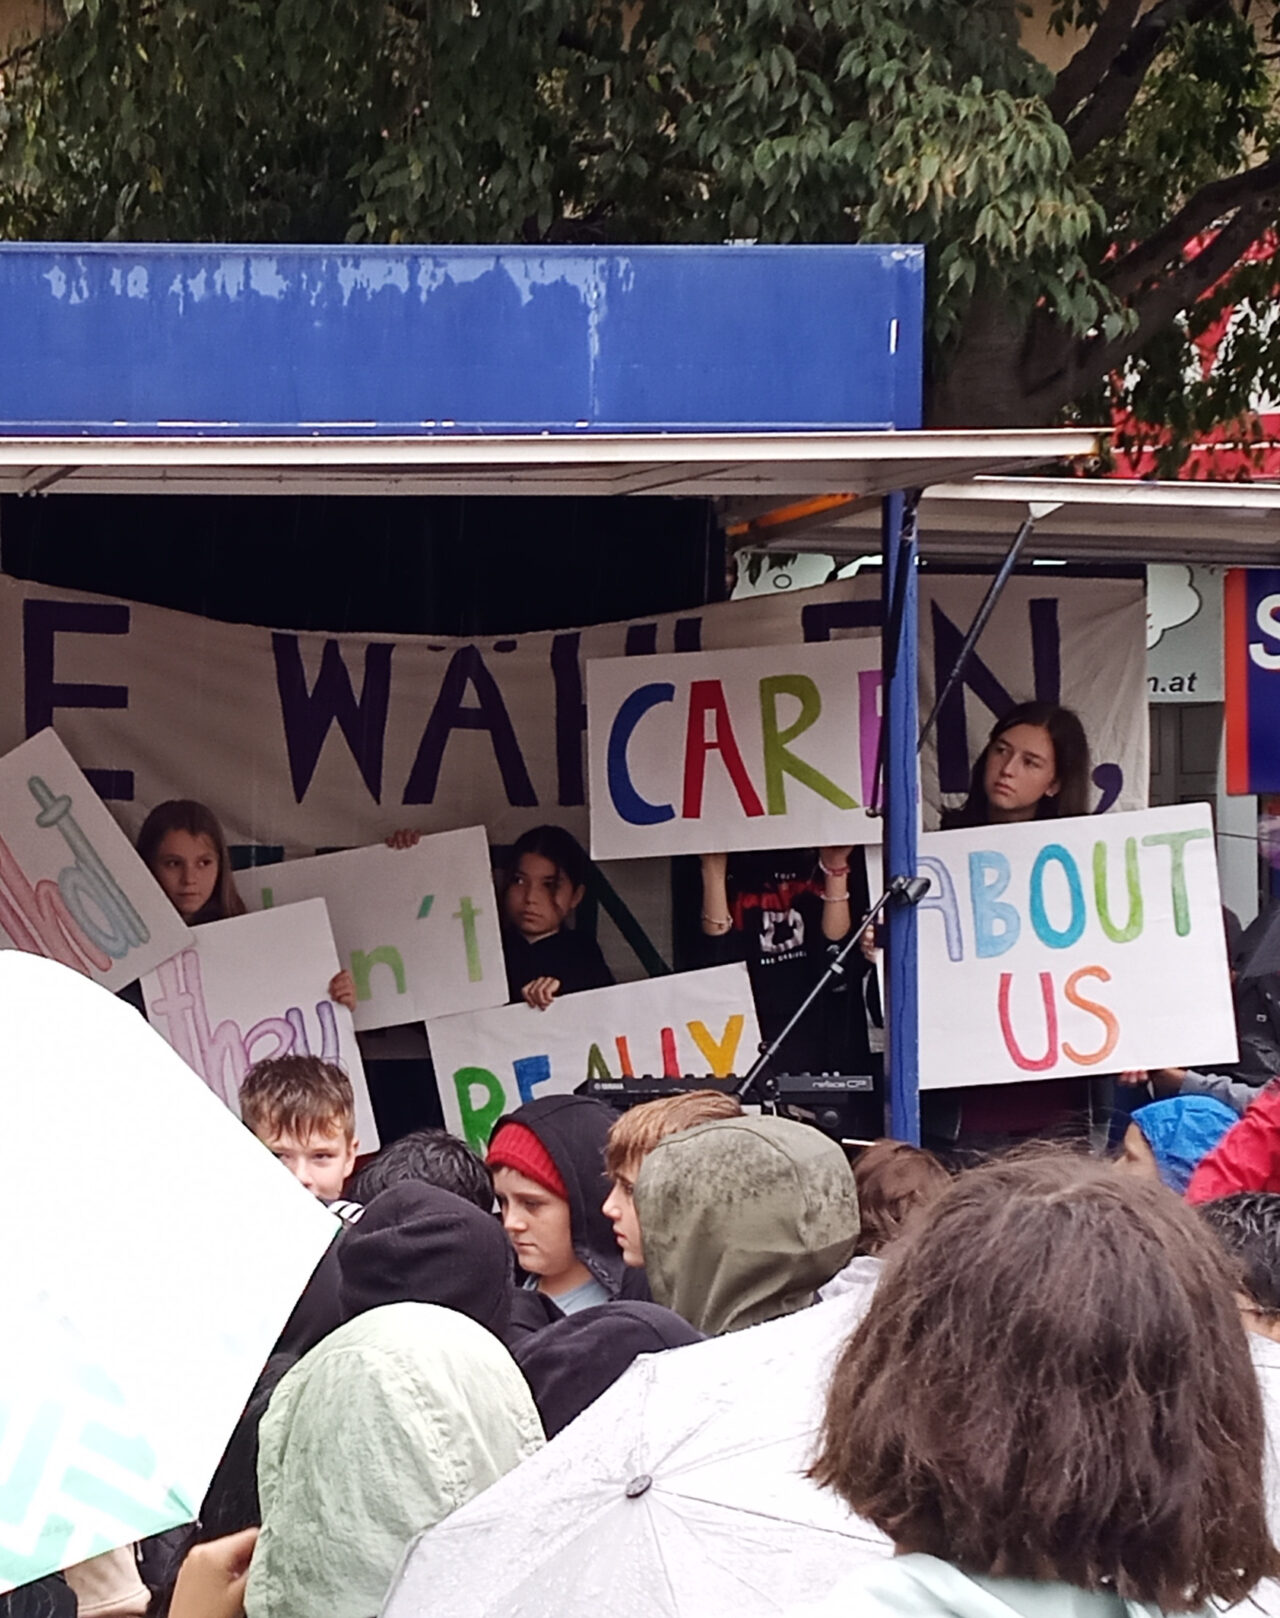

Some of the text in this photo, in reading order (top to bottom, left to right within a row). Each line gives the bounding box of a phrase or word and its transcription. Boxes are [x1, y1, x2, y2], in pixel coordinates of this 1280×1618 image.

[261, 887, 483, 1001] n't
[917, 828, 1211, 963] ABOUT
[998, 965, 1120, 1072] US
